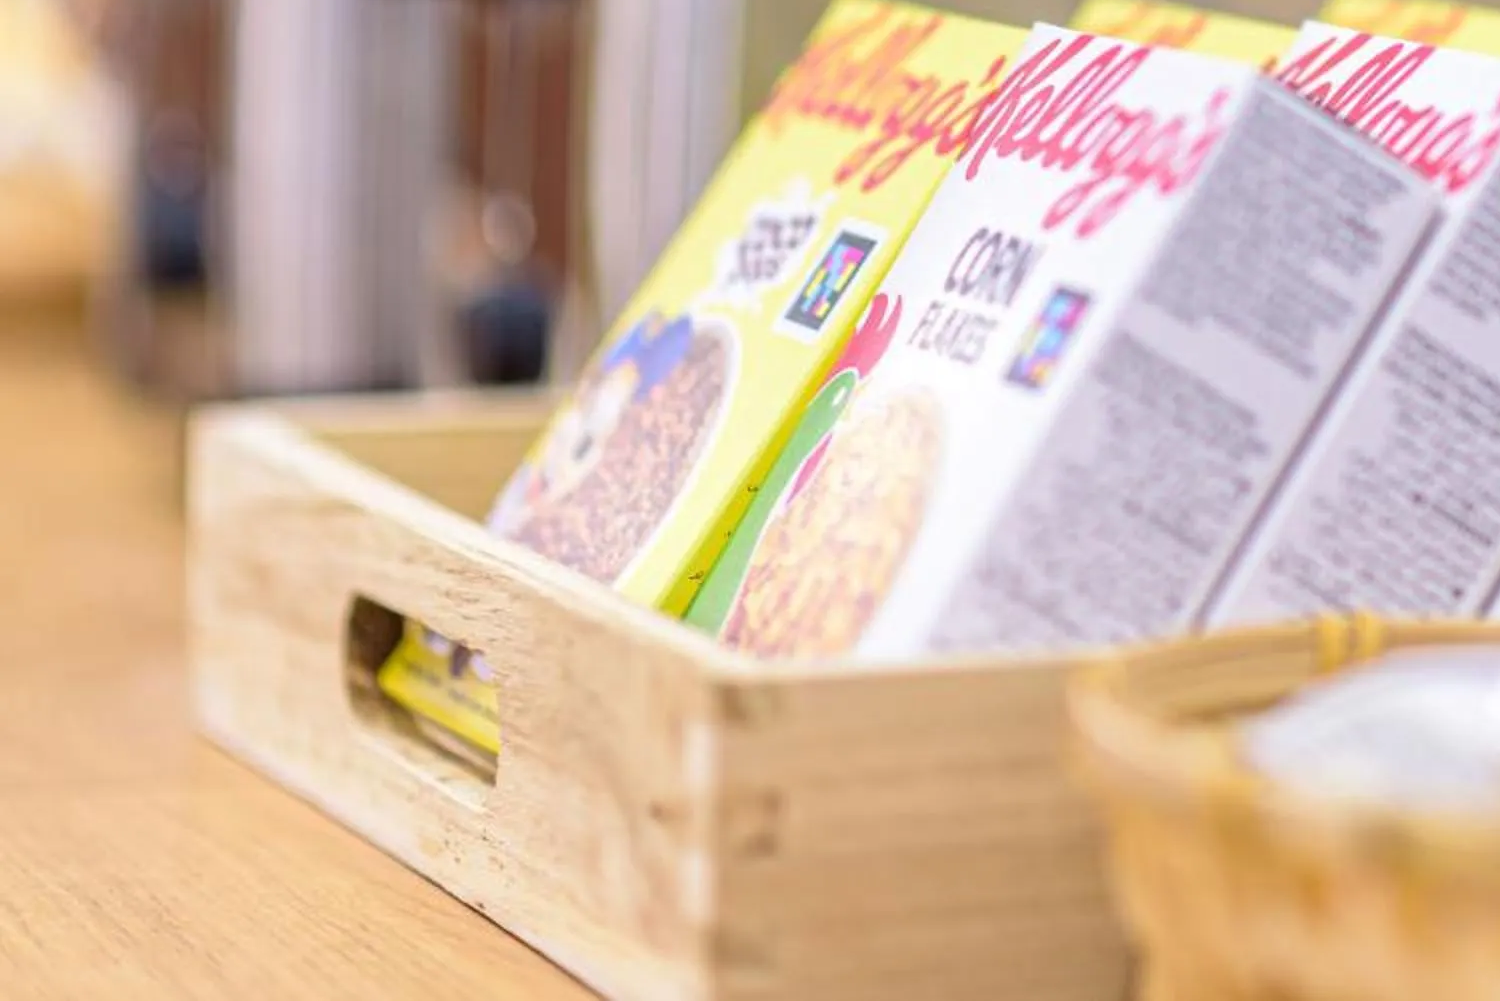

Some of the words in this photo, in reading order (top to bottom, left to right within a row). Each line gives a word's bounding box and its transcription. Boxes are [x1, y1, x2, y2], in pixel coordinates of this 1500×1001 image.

[957, 33, 1231, 238] Kellogg's
[944, 227, 1043, 307] CORN
[907, 300, 998, 364] FLAKES
